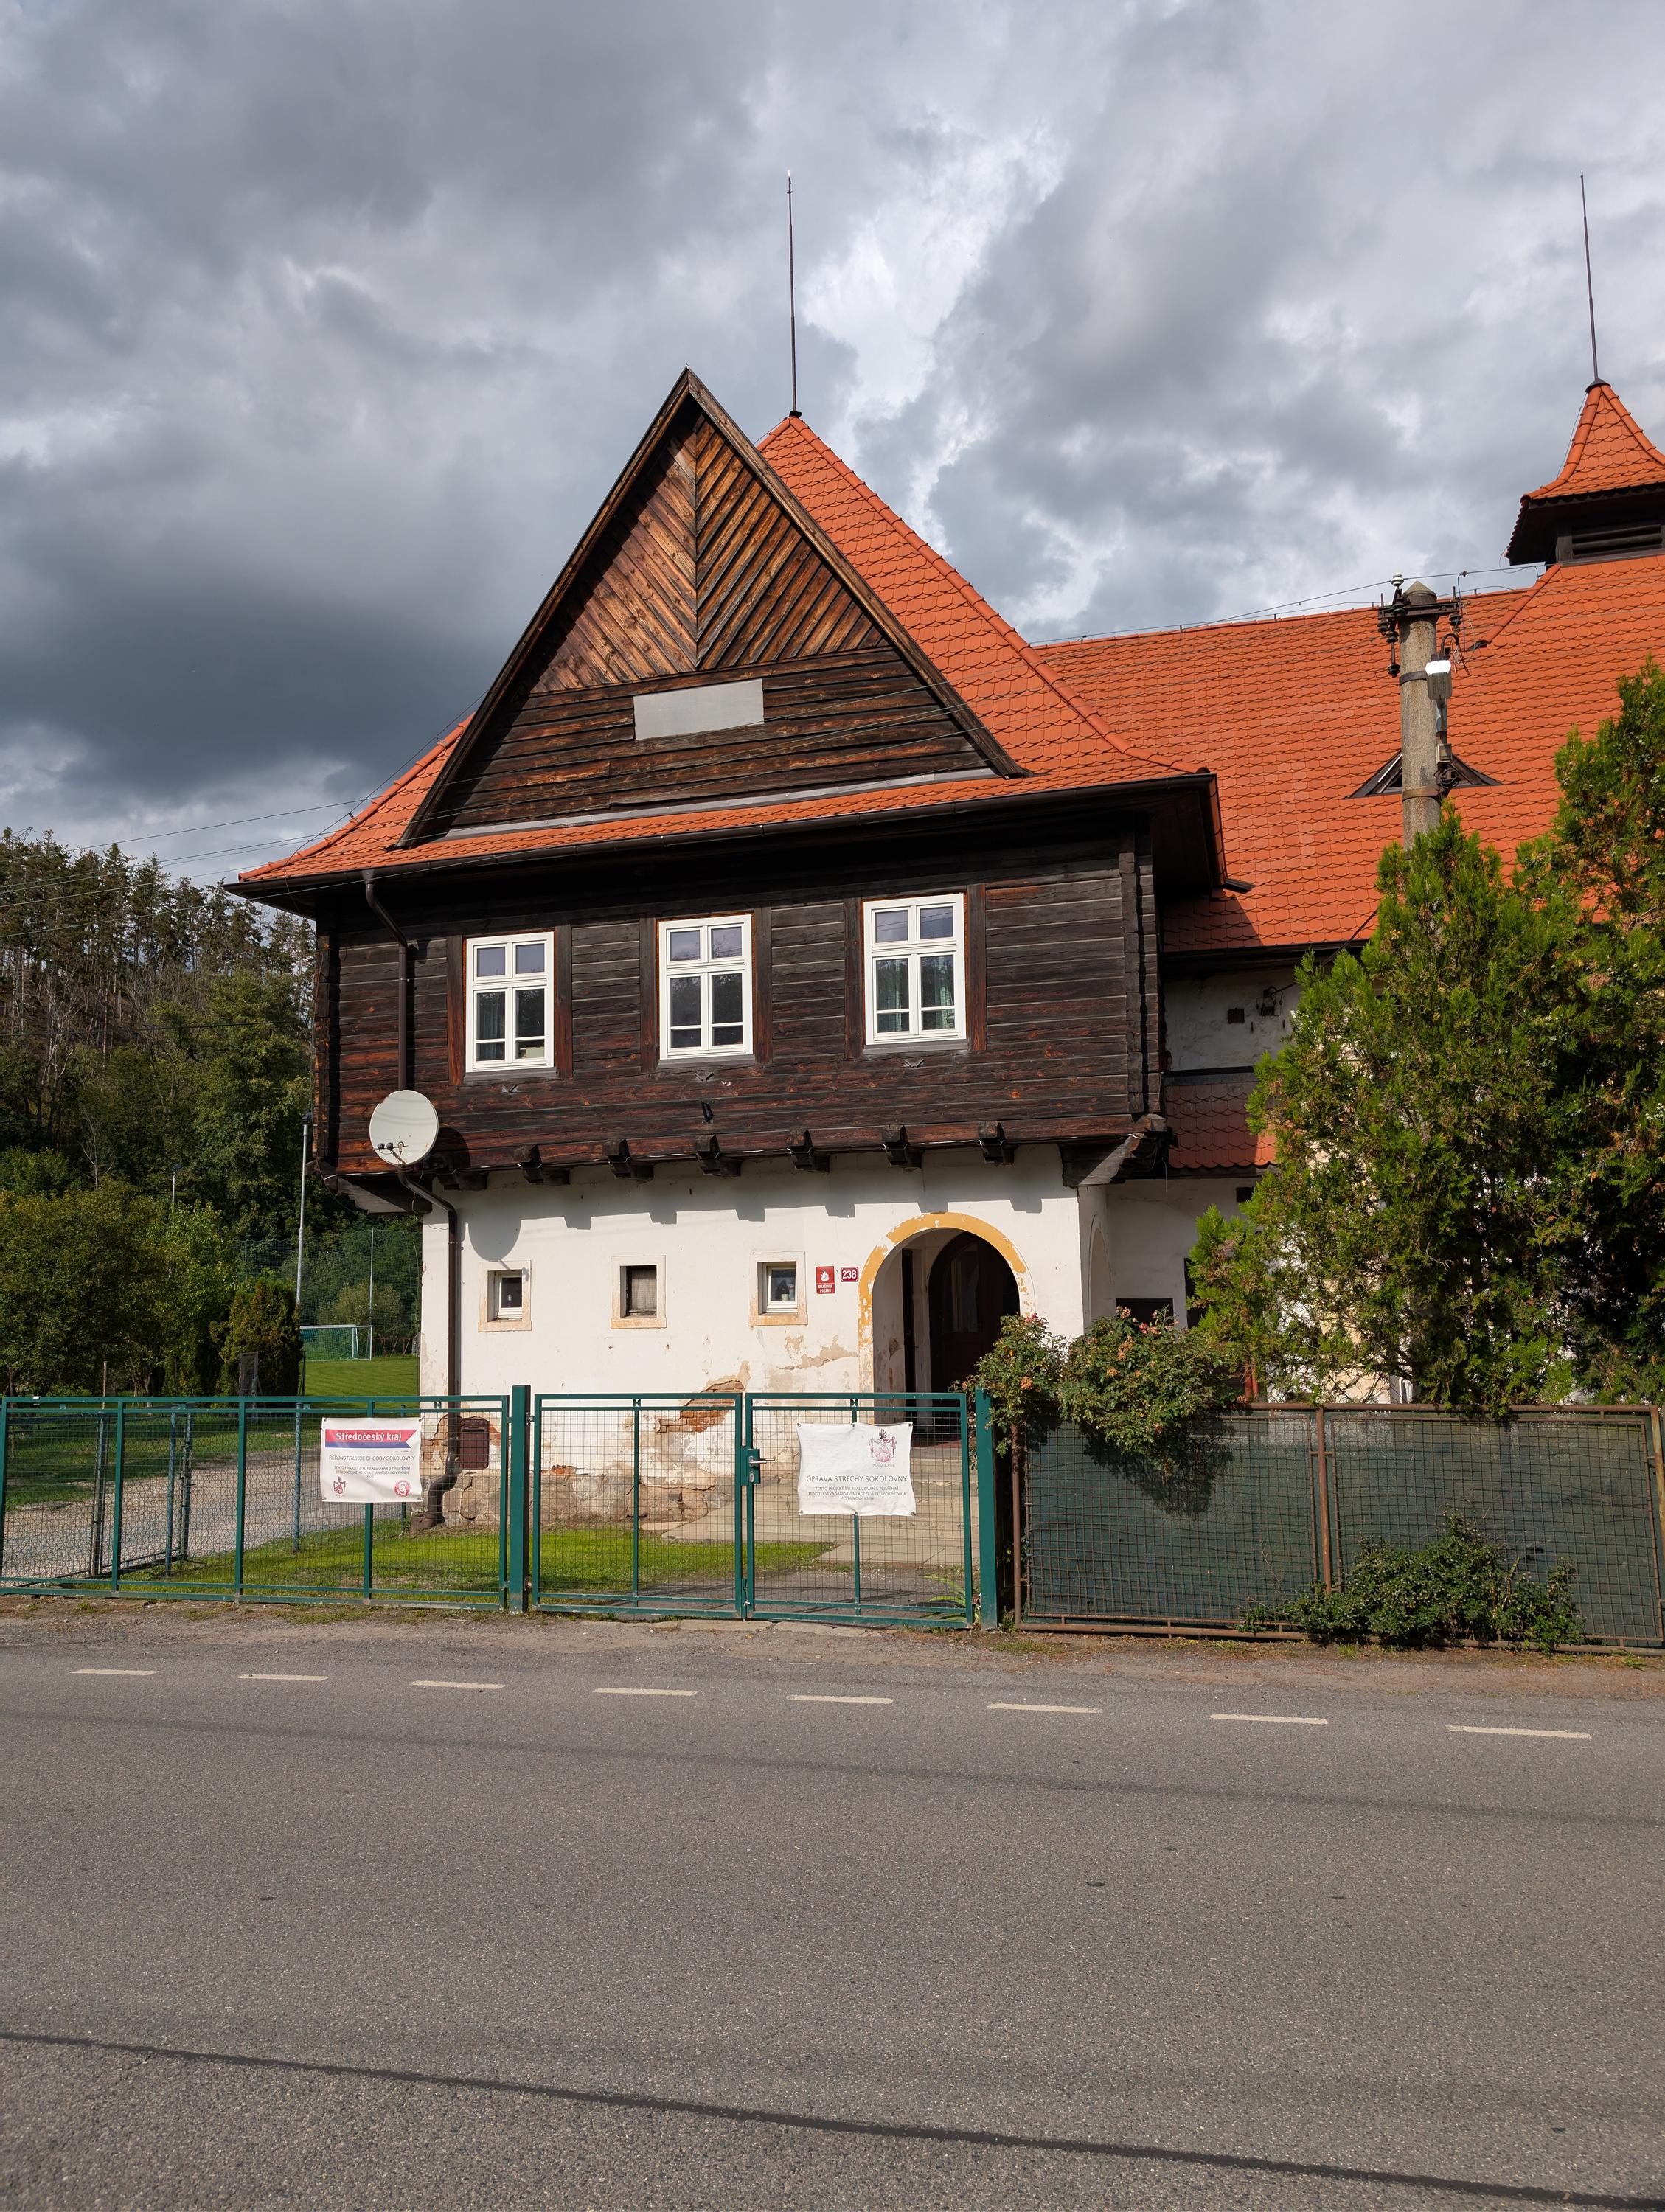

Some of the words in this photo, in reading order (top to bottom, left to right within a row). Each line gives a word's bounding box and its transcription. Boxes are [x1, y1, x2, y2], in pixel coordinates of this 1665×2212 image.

[842, 1270, 857, 1279] 236
[336, 1432, 384, 1442] Středočeský
[386, 1432, 401, 1441] kraj
